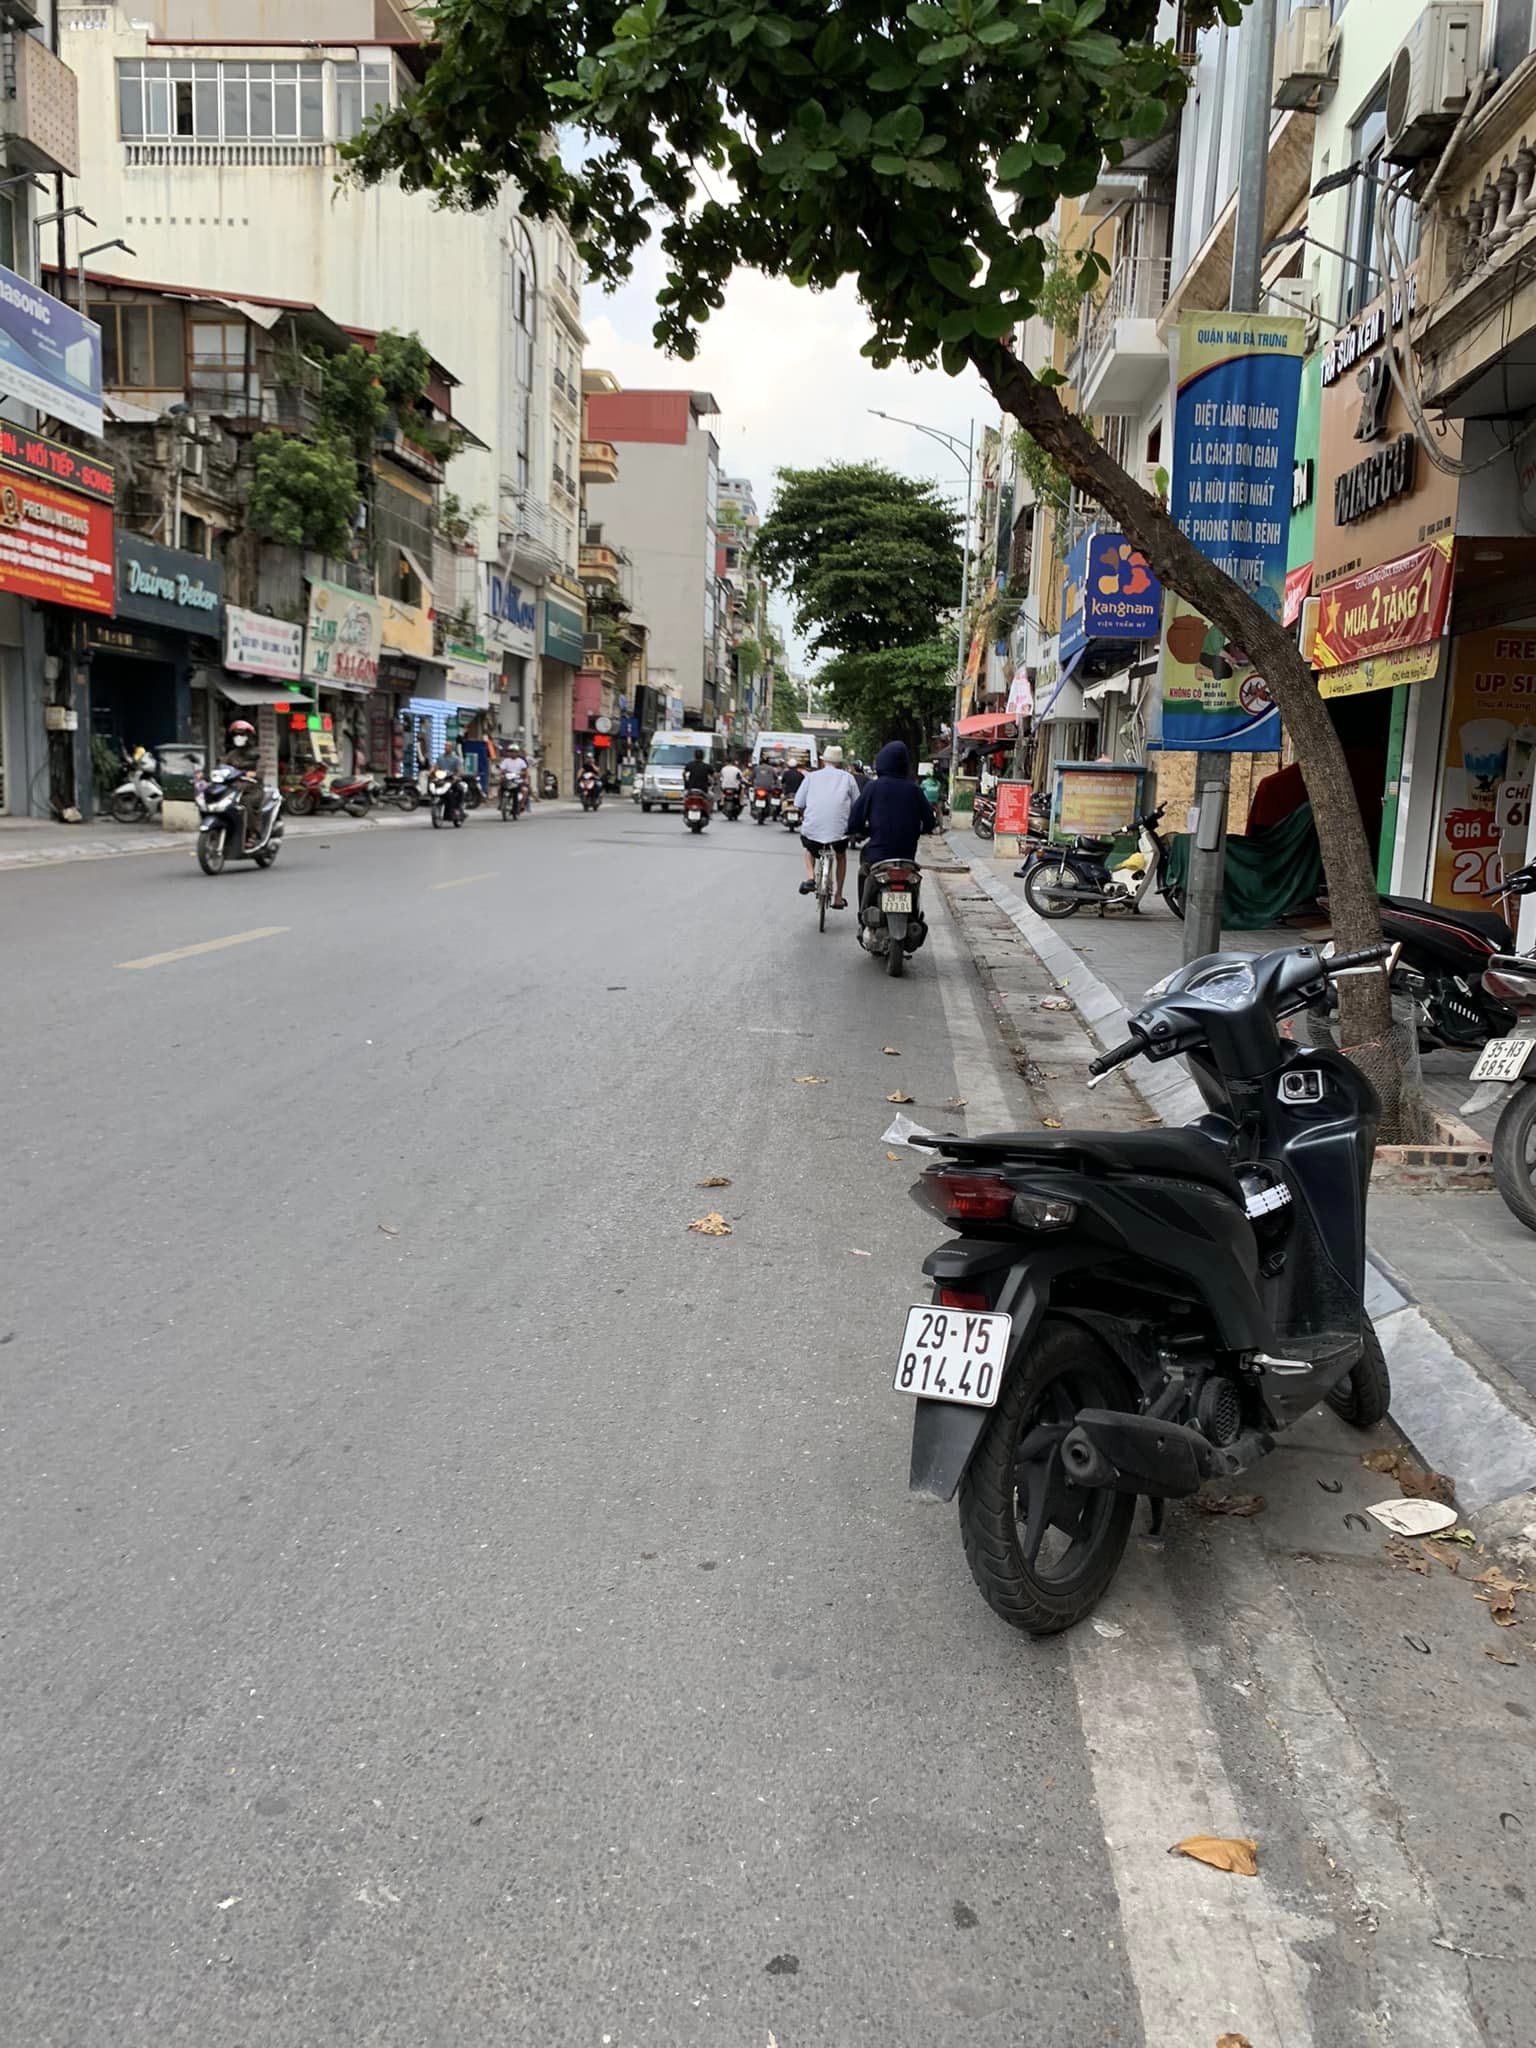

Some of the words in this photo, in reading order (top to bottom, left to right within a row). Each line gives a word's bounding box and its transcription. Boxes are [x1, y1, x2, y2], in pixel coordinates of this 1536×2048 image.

[1197, 328, 1224, 347] QUẬN
[1226, 330, 1242, 345] HAI
[1243, 329, 1255, 346] BÀ
[1357, 309, 1380, 357] KEM
[1195, 399, 1218, 431] DIỆT
[1190, 438, 1202, 465] LÀ
[1205, 438, 1233, 465] CÁCH
[1254, 438, 1278, 469] GIẢN
[1189, 476, 1202, 503] VÀ
[1249, 476, 1275, 507] NHẤT
[1193, 514, 1228, 541] PHÒNG
[1255, 518, 1281, 549] BỆNH
[1092, 597, 1154, 617] kangnam
[1343, 603, 1369, 639] MUA
[1370, 586, 1381, 631] 2
[1383, 585, 1420, 633] TẶNG
[1422, 566, 1433, 614] 1
[1169, 686, 1191, 698] KHÔNG
[1474, 671, 1507, 693] UP
[1511, 672, 1536, 695] SI
[1453, 817, 1481, 838] GIÁ
[1478, 1059, 1516, 1076] 9854
[916, 1313, 993, 1355] 29-Y5
[900, 1352, 993, 1399] 814.40
